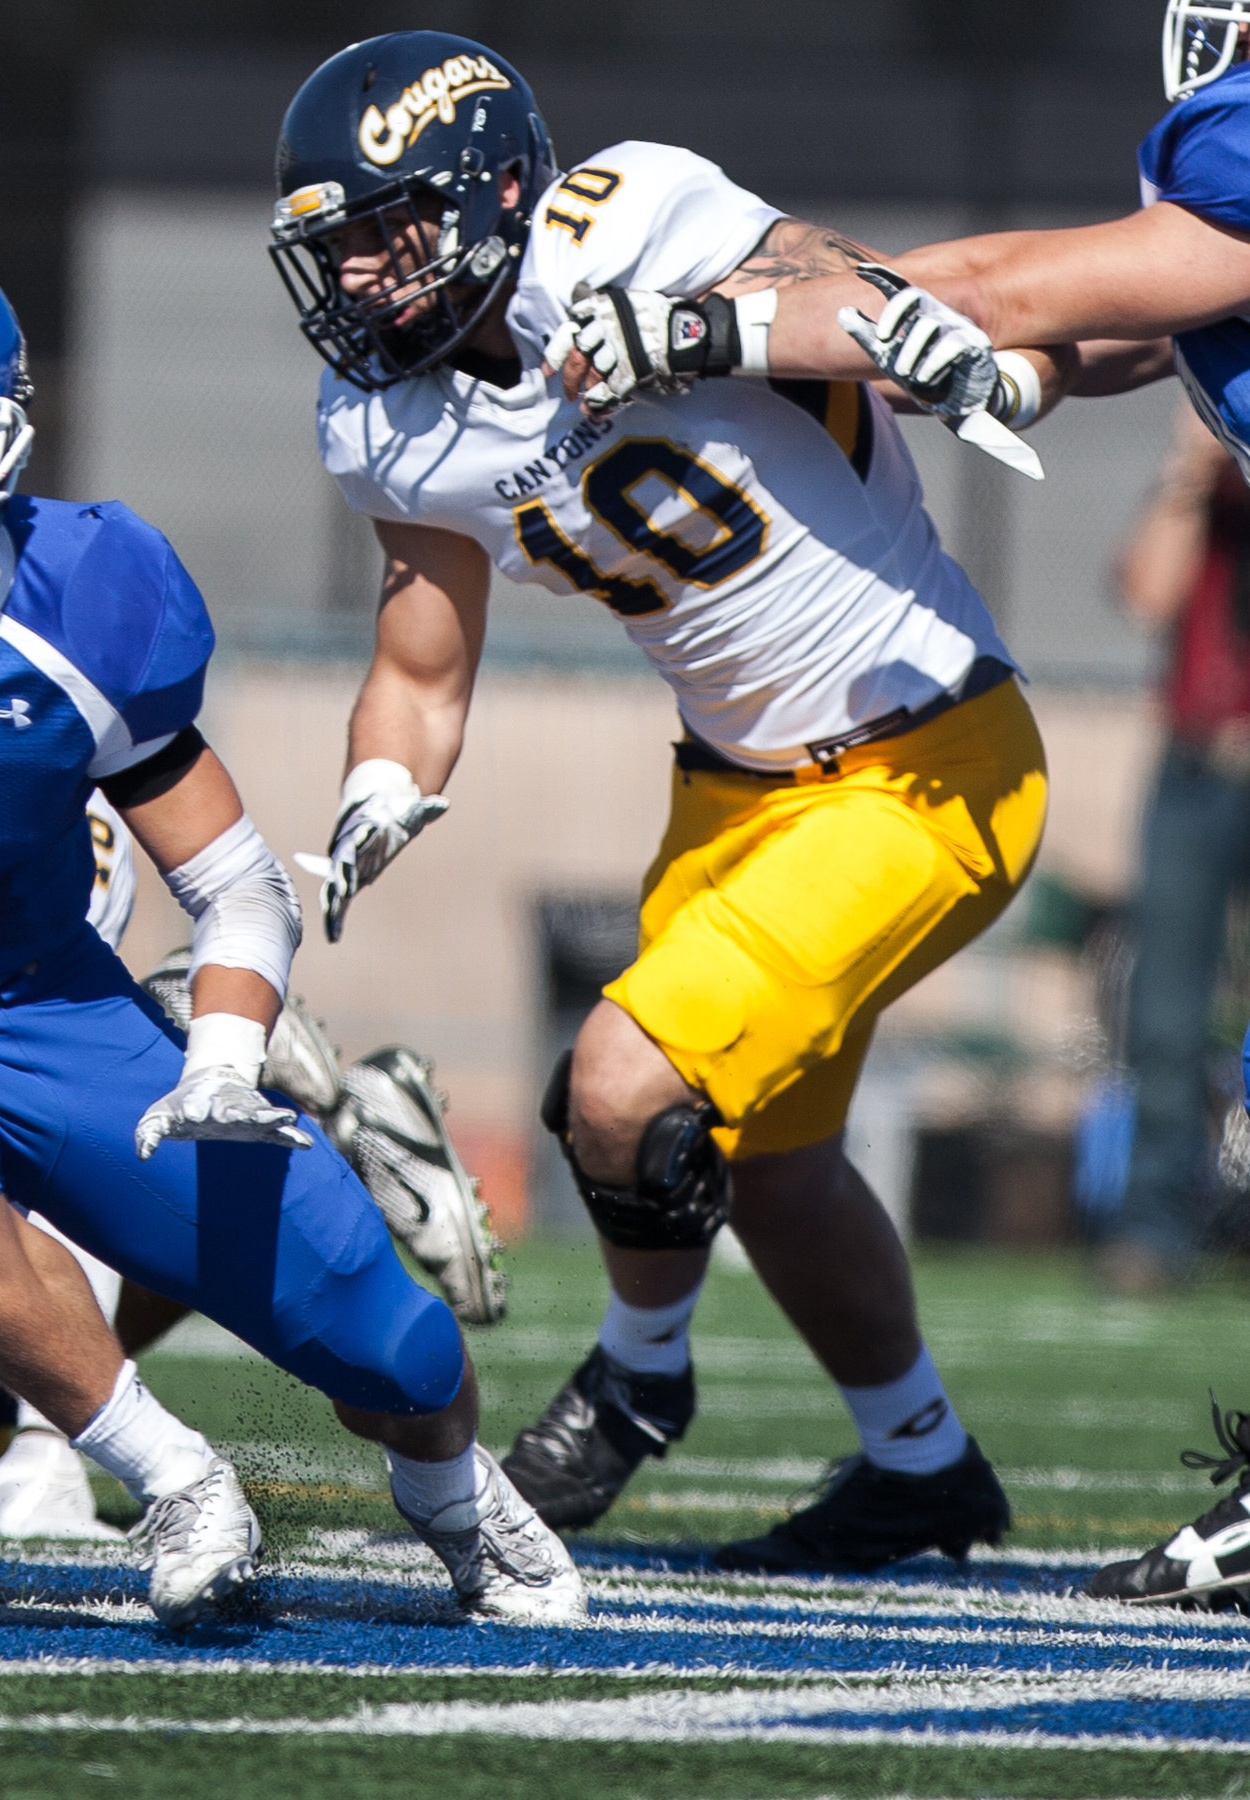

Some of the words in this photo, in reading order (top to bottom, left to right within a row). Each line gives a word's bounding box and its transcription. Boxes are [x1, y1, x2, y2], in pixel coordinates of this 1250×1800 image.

[359, 54, 512, 165] Cougars
[543, 166, 625, 249] 10
[494, 418, 613, 500] CANYONS
[512, 436, 771, 617] 10
